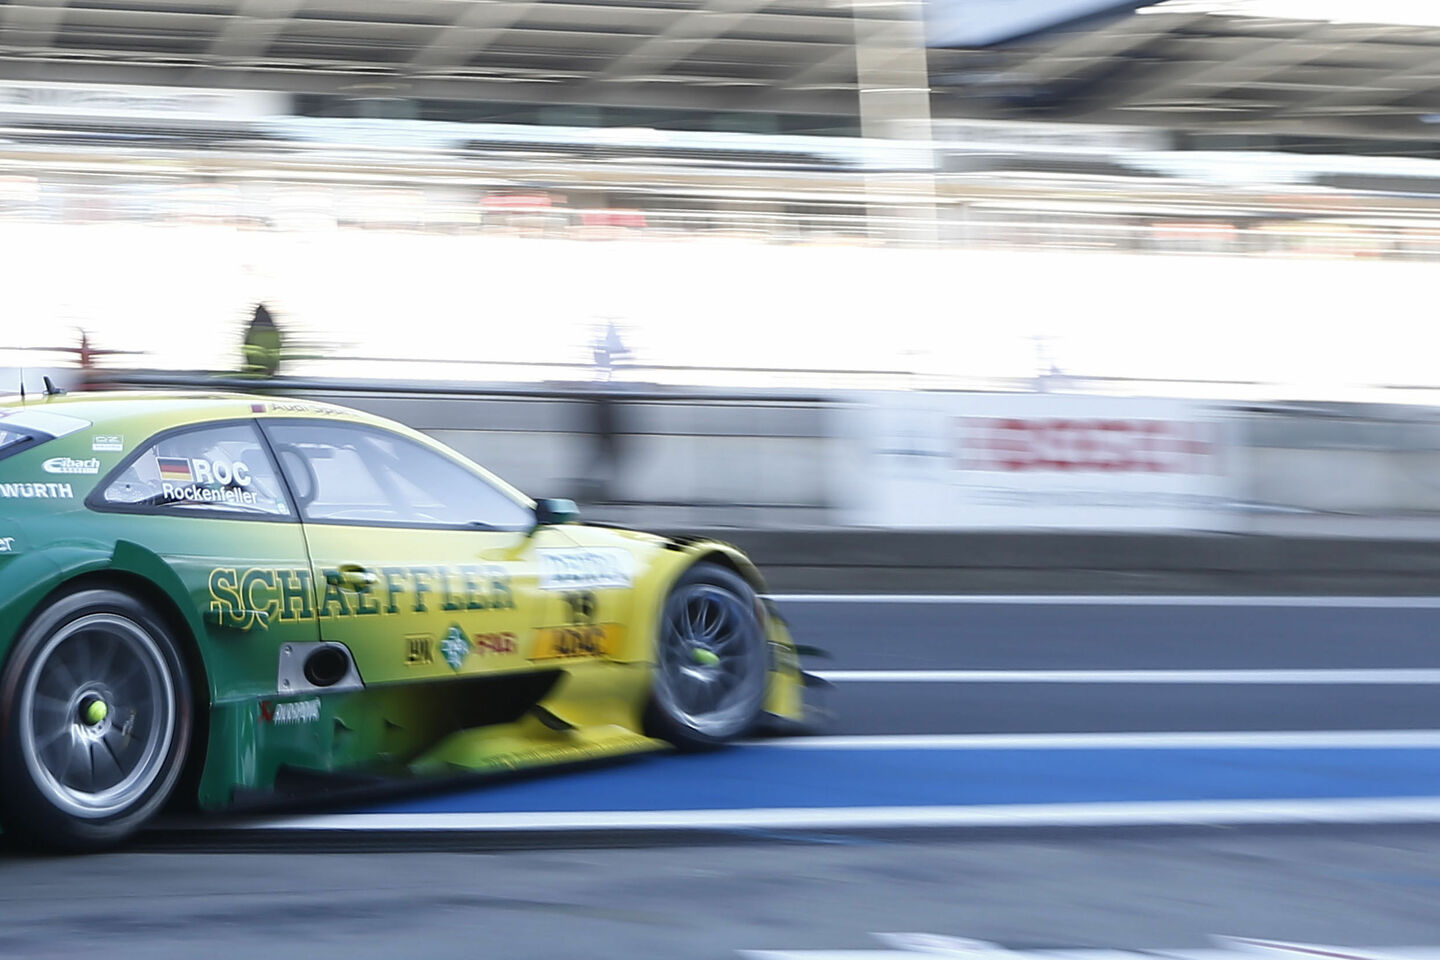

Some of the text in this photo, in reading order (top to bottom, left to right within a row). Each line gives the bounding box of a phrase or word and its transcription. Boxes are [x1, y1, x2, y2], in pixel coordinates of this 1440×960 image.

[192, 458, 252, 486] ROC
[161, 482, 258, 505] Rockenfeller
[209, 564, 516, 631] SCHAEFFLER
